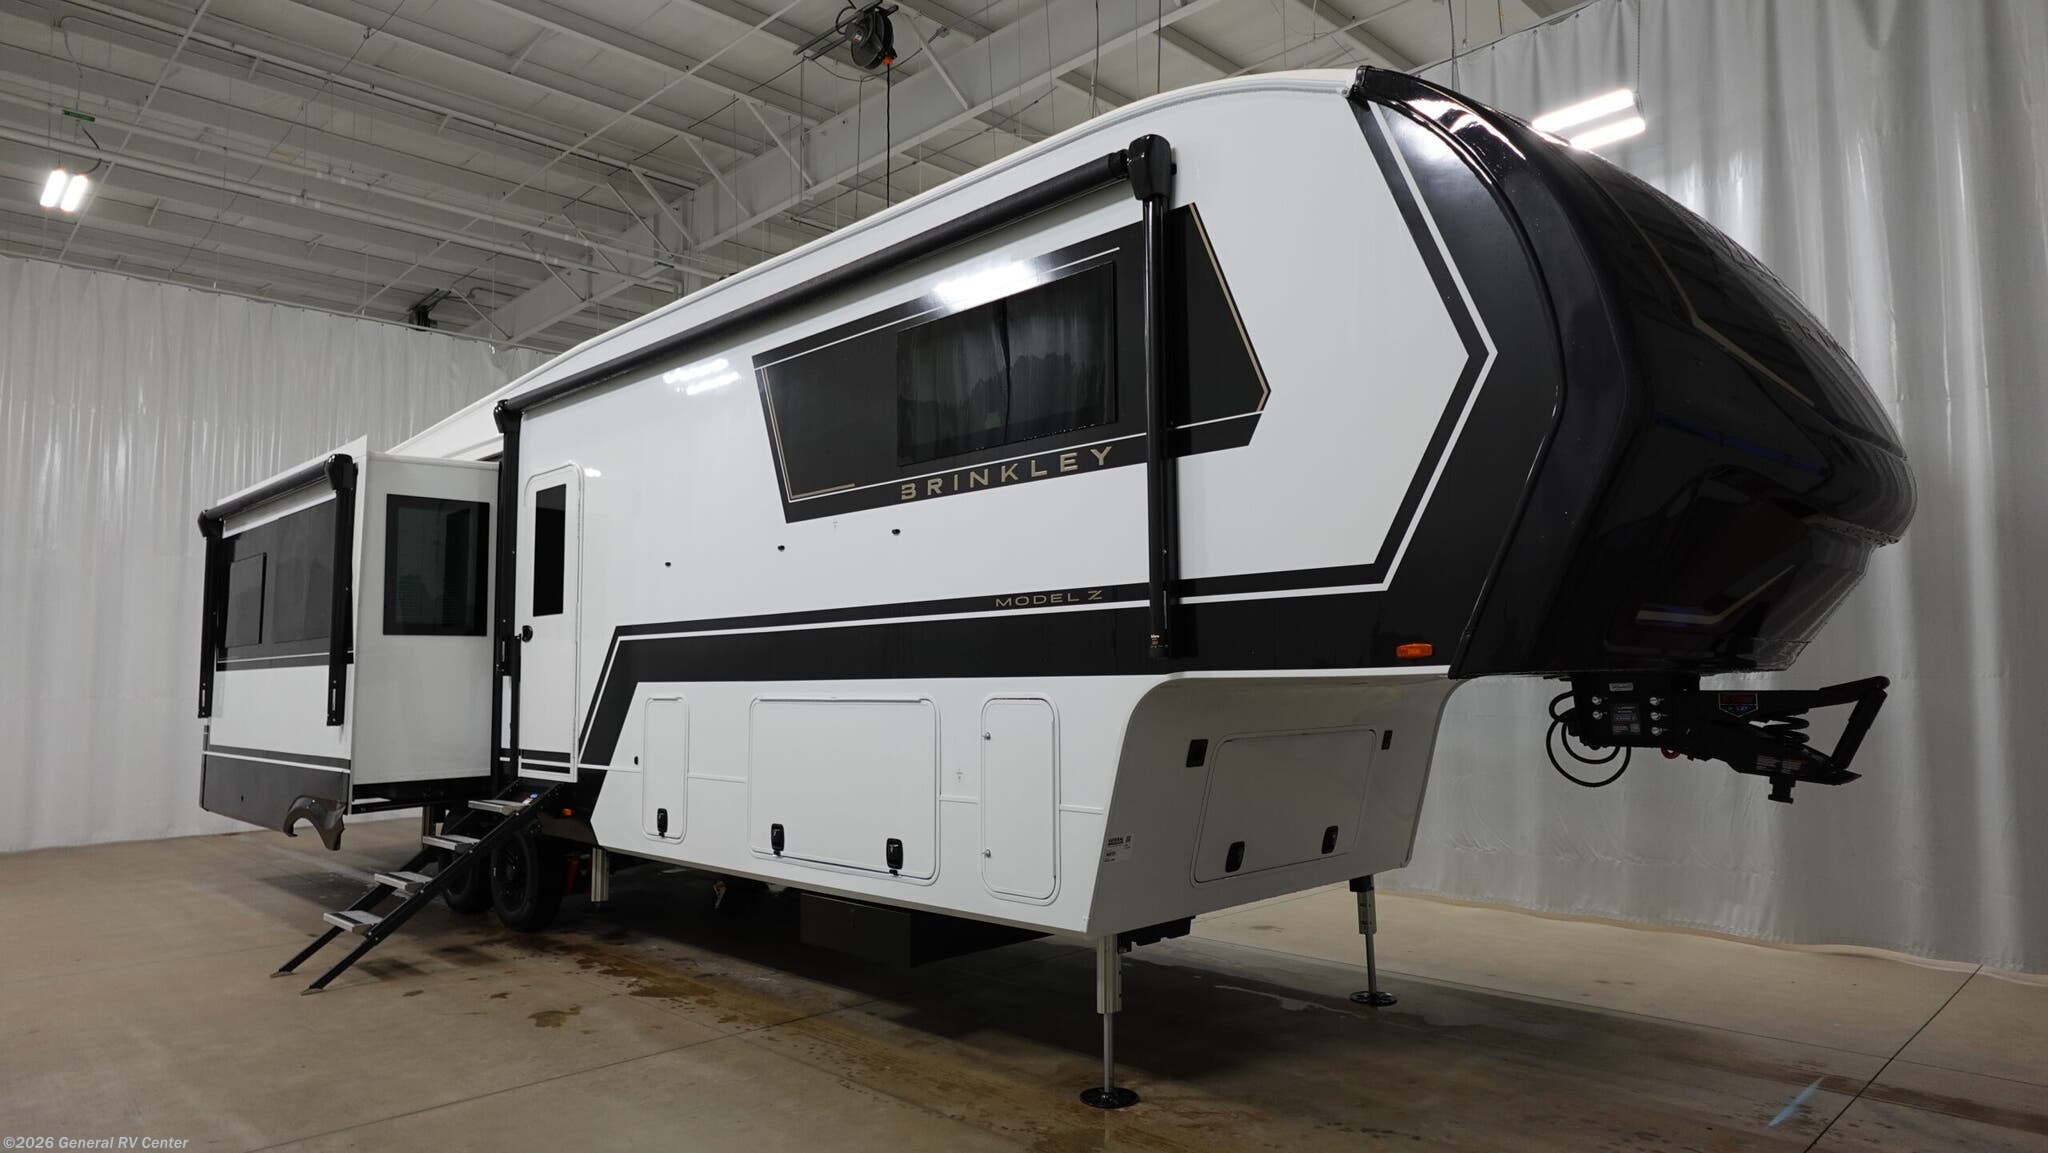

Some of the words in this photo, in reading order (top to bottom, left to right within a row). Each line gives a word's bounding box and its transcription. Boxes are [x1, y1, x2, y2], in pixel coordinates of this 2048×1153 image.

[901, 446, 1112, 500] BRINKLEY
[995, 593, 1080, 607] MODEL
[1087, 590, 1103, 600] Z
